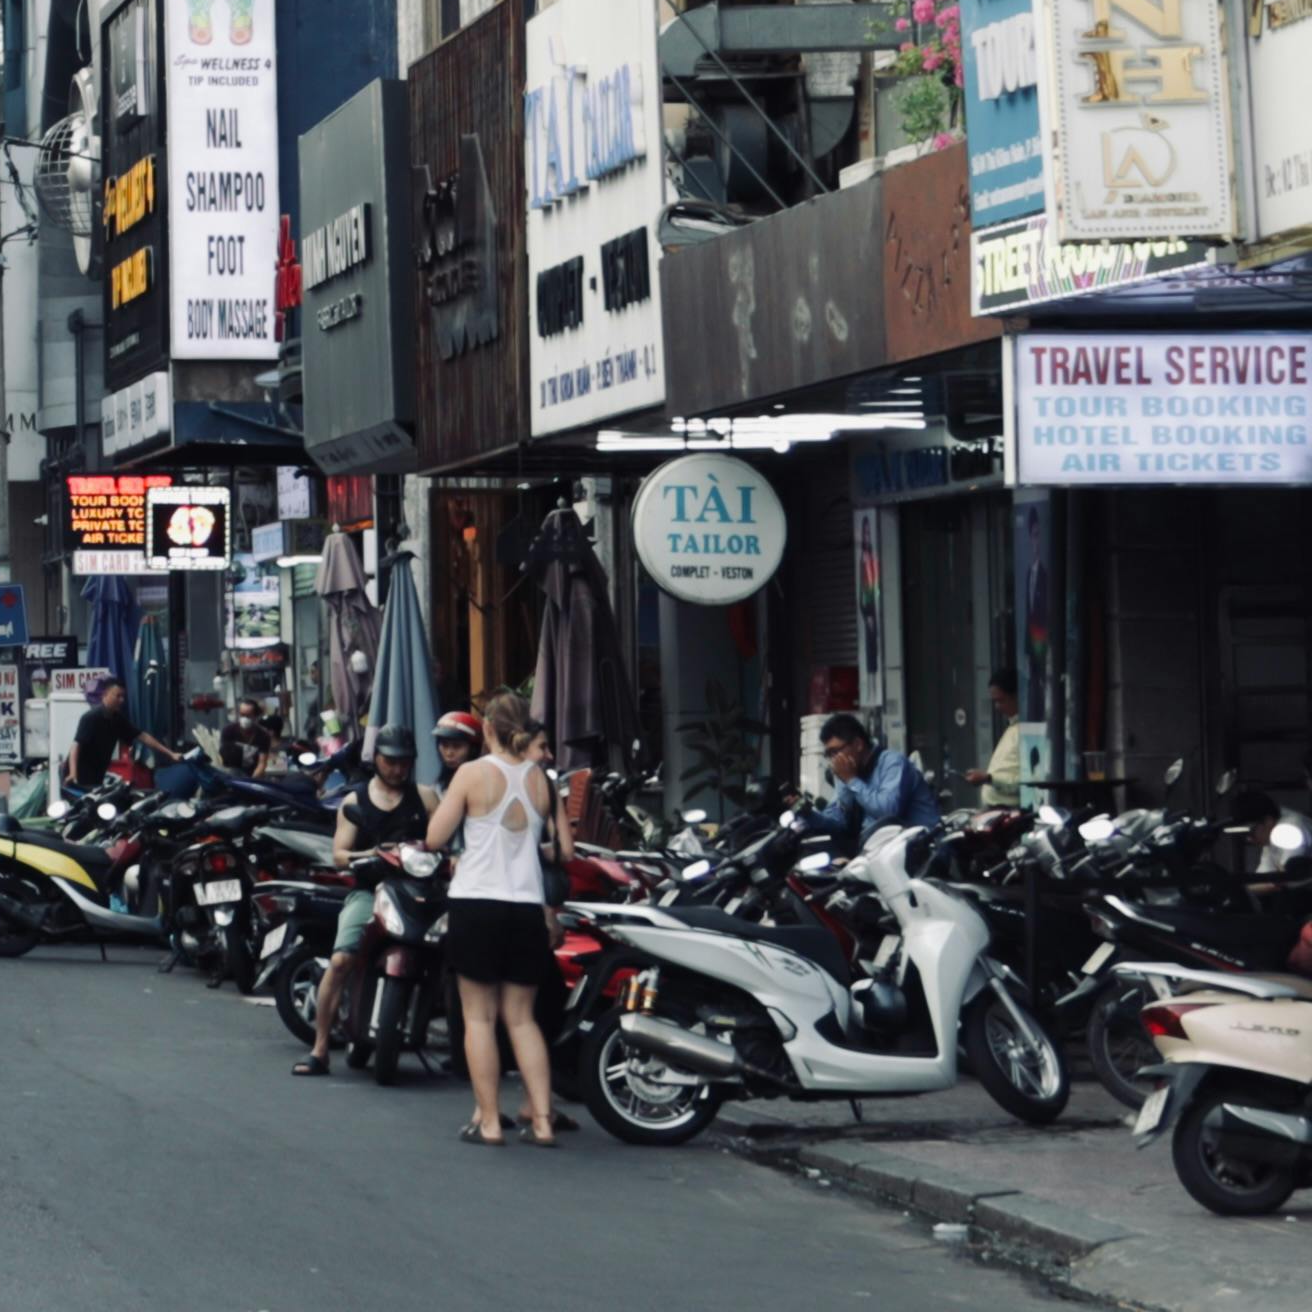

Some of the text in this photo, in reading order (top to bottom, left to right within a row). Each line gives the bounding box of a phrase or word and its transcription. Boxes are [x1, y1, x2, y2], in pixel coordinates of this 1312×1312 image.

[201, 57, 261, 71] WELLNESS
[206, 108, 243, 149] NAIL
[187, 171, 266, 213] SHAMPOO
[208, 235, 245, 276] FOOT
[187, 297, 214, 340] BODY
[217, 297, 269, 340] MASSAGE
[1030, 345, 1307, 386] TRAVEL SERVICE
[1033, 395, 1307, 418] TOUR BOOKING
[1033, 425, 1307, 446] HOTEL BOOKING
[1061, 452, 1282, 472] AIR TICKETS
[71, 496, 107, 507] TOUR
[663, 473, 758, 524] TÀI
[71, 508, 124, 520] LUXURY
[72, 520, 126, 532] PRIVATE
[82, 532, 104, 544] AIR
[667, 533, 762, 556] TAILOR
[671, 565, 710, 578] COMPLET
[721, 566, 754, 580] VESTON
[24, 642, 68, 658] REE
[55, 672, 76, 690] SIM
